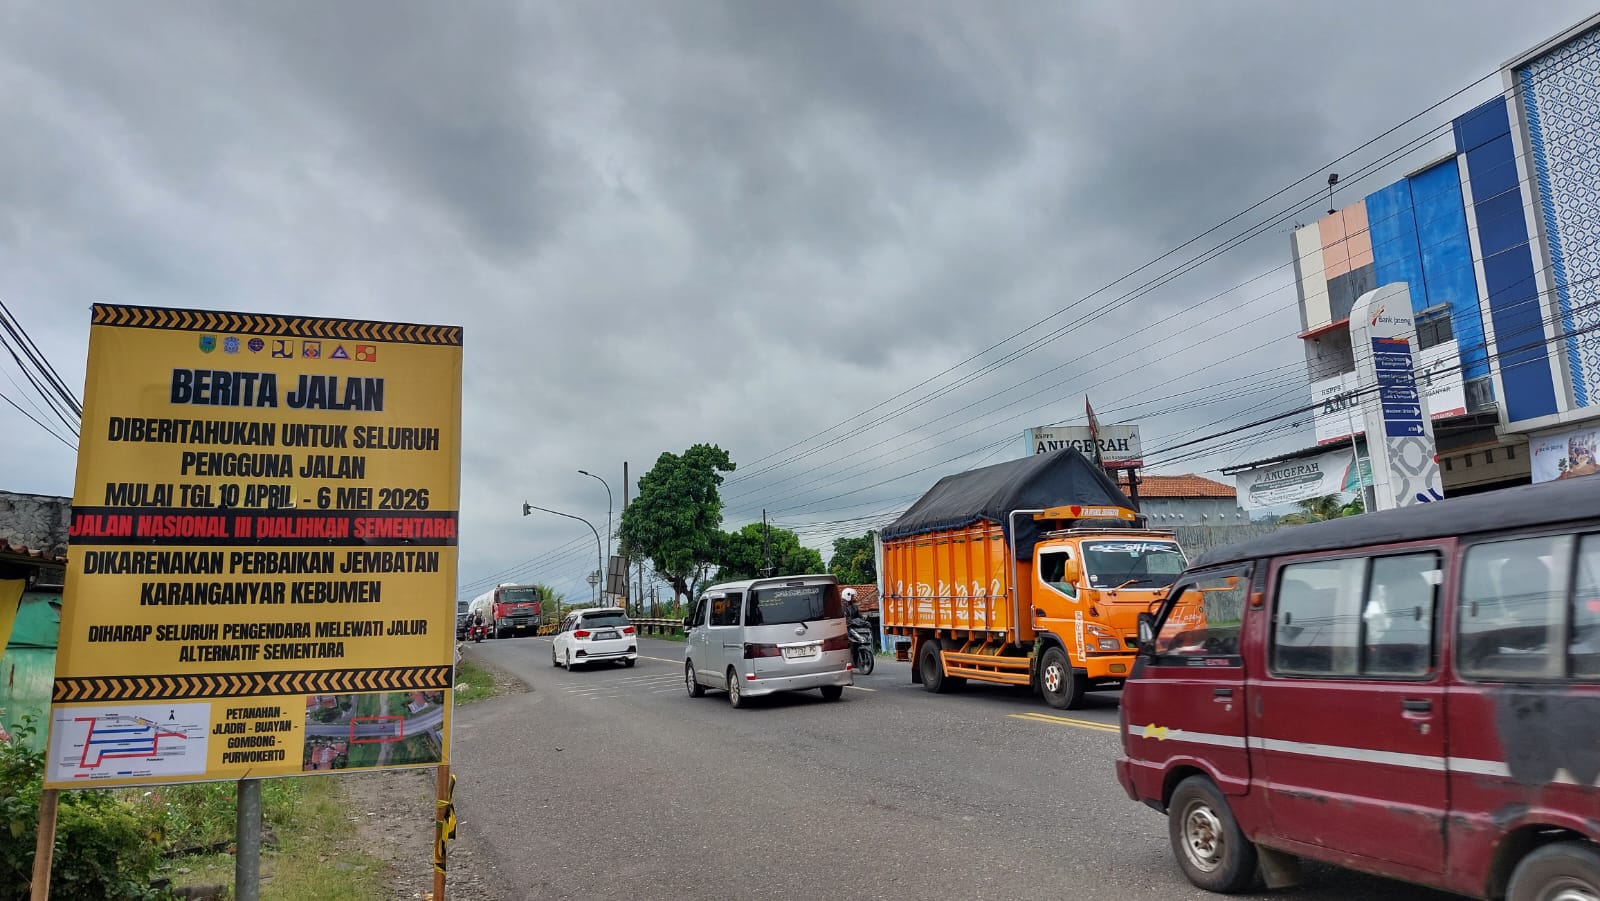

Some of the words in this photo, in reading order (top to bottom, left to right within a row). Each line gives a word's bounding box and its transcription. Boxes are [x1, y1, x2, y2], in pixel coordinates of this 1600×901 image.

[170, 368, 277, 408] BERITA
[287, 374, 385, 412] JALAN
[108, 416, 276, 446] DIBERITAHUKAN
[282, 424, 348, 448] UNTUK
[353, 426, 440, 451] SELURUH
[1036, 438, 1129, 454] ANUGERAH
[180, 451, 293, 478] PENGGUNA
[299, 454, 365, 479] JALAN
[1264, 463, 1319, 481] ANUGERAH
[105, 483, 177, 507] MULAI
[180, 484, 214, 508] TGL
[218, 484, 240, 509] 10
[243, 486, 294, 509] APRIL
[317, 487, 331, 509] 6
[337, 488, 373, 509] MEI
[378, 488, 430, 510] 2026
[69, 514, 132, 538] JALAN
[137, 515, 229, 538] NASIONAL
[234, 516, 251, 538] III
[257, 516, 349, 538] DIALIHKAN
[353, 517, 456, 539] SEMENTARA
[84, 551, 224, 575] DIKARENAKAN
[229, 551, 334, 574] PERBAIKAN
[339, 549, 439, 573] JEMBATAN
[140, 581, 285, 606] KARANGANYAR
[291, 580, 381, 604] KEBUMEN
[88, 625, 153, 643] DIHARAP
[156, 623, 219, 641] SELURUH
[222, 621, 311, 640] PENGENDARA
[315, 620, 384, 639] MELEWATI
[387, 619, 428, 637] JALUR
[179, 643, 260, 662] ALTERNATIF
[264, 642, 344, 661] SEMENTARA
[226, 706, 281, 720] PETANAHAN
[212, 721, 246, 735] JLADRI
[255, 719, 292, 733] BUAYAN
[228, 735, 275, 749] GOMBONG
[222, 749, 285, 764] PURWOKERTO
